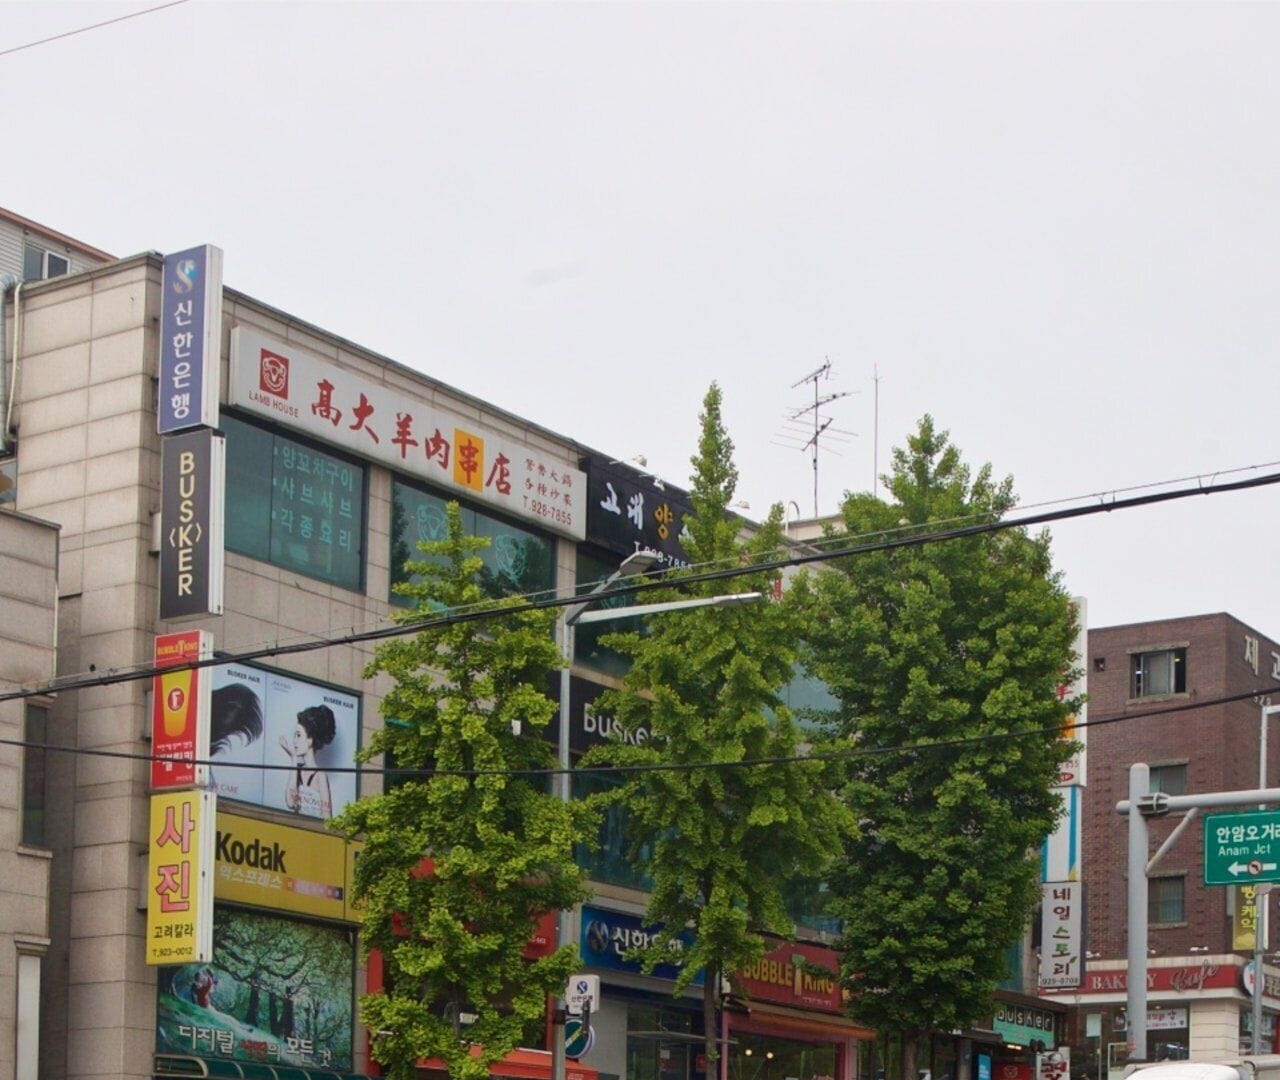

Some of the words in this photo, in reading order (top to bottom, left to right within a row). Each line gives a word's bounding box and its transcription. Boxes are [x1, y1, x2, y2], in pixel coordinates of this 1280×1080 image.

[170, 299, 194, 420] 신한은행
[248, 390, 271, 406] LAMB
[272, 399, 299, 418] HOUSE
[282, 446, 353, 492] 양꼬치구이
[175, 452, 197, 597] BUSKER
[523, 495, 573, 525] T.928-7855
[156, 801, 196, 913] 사진
[215, 830, 287, 874] Kodak
[1218, 843, 1250, 857] Anam
[1252, 843, 1271, 856] Jct
[220, 866, 282, 889] 익스프레스
[153, 924, 195, 939] 고려칼라
[178, 1025, 234, 1054] 디지털
